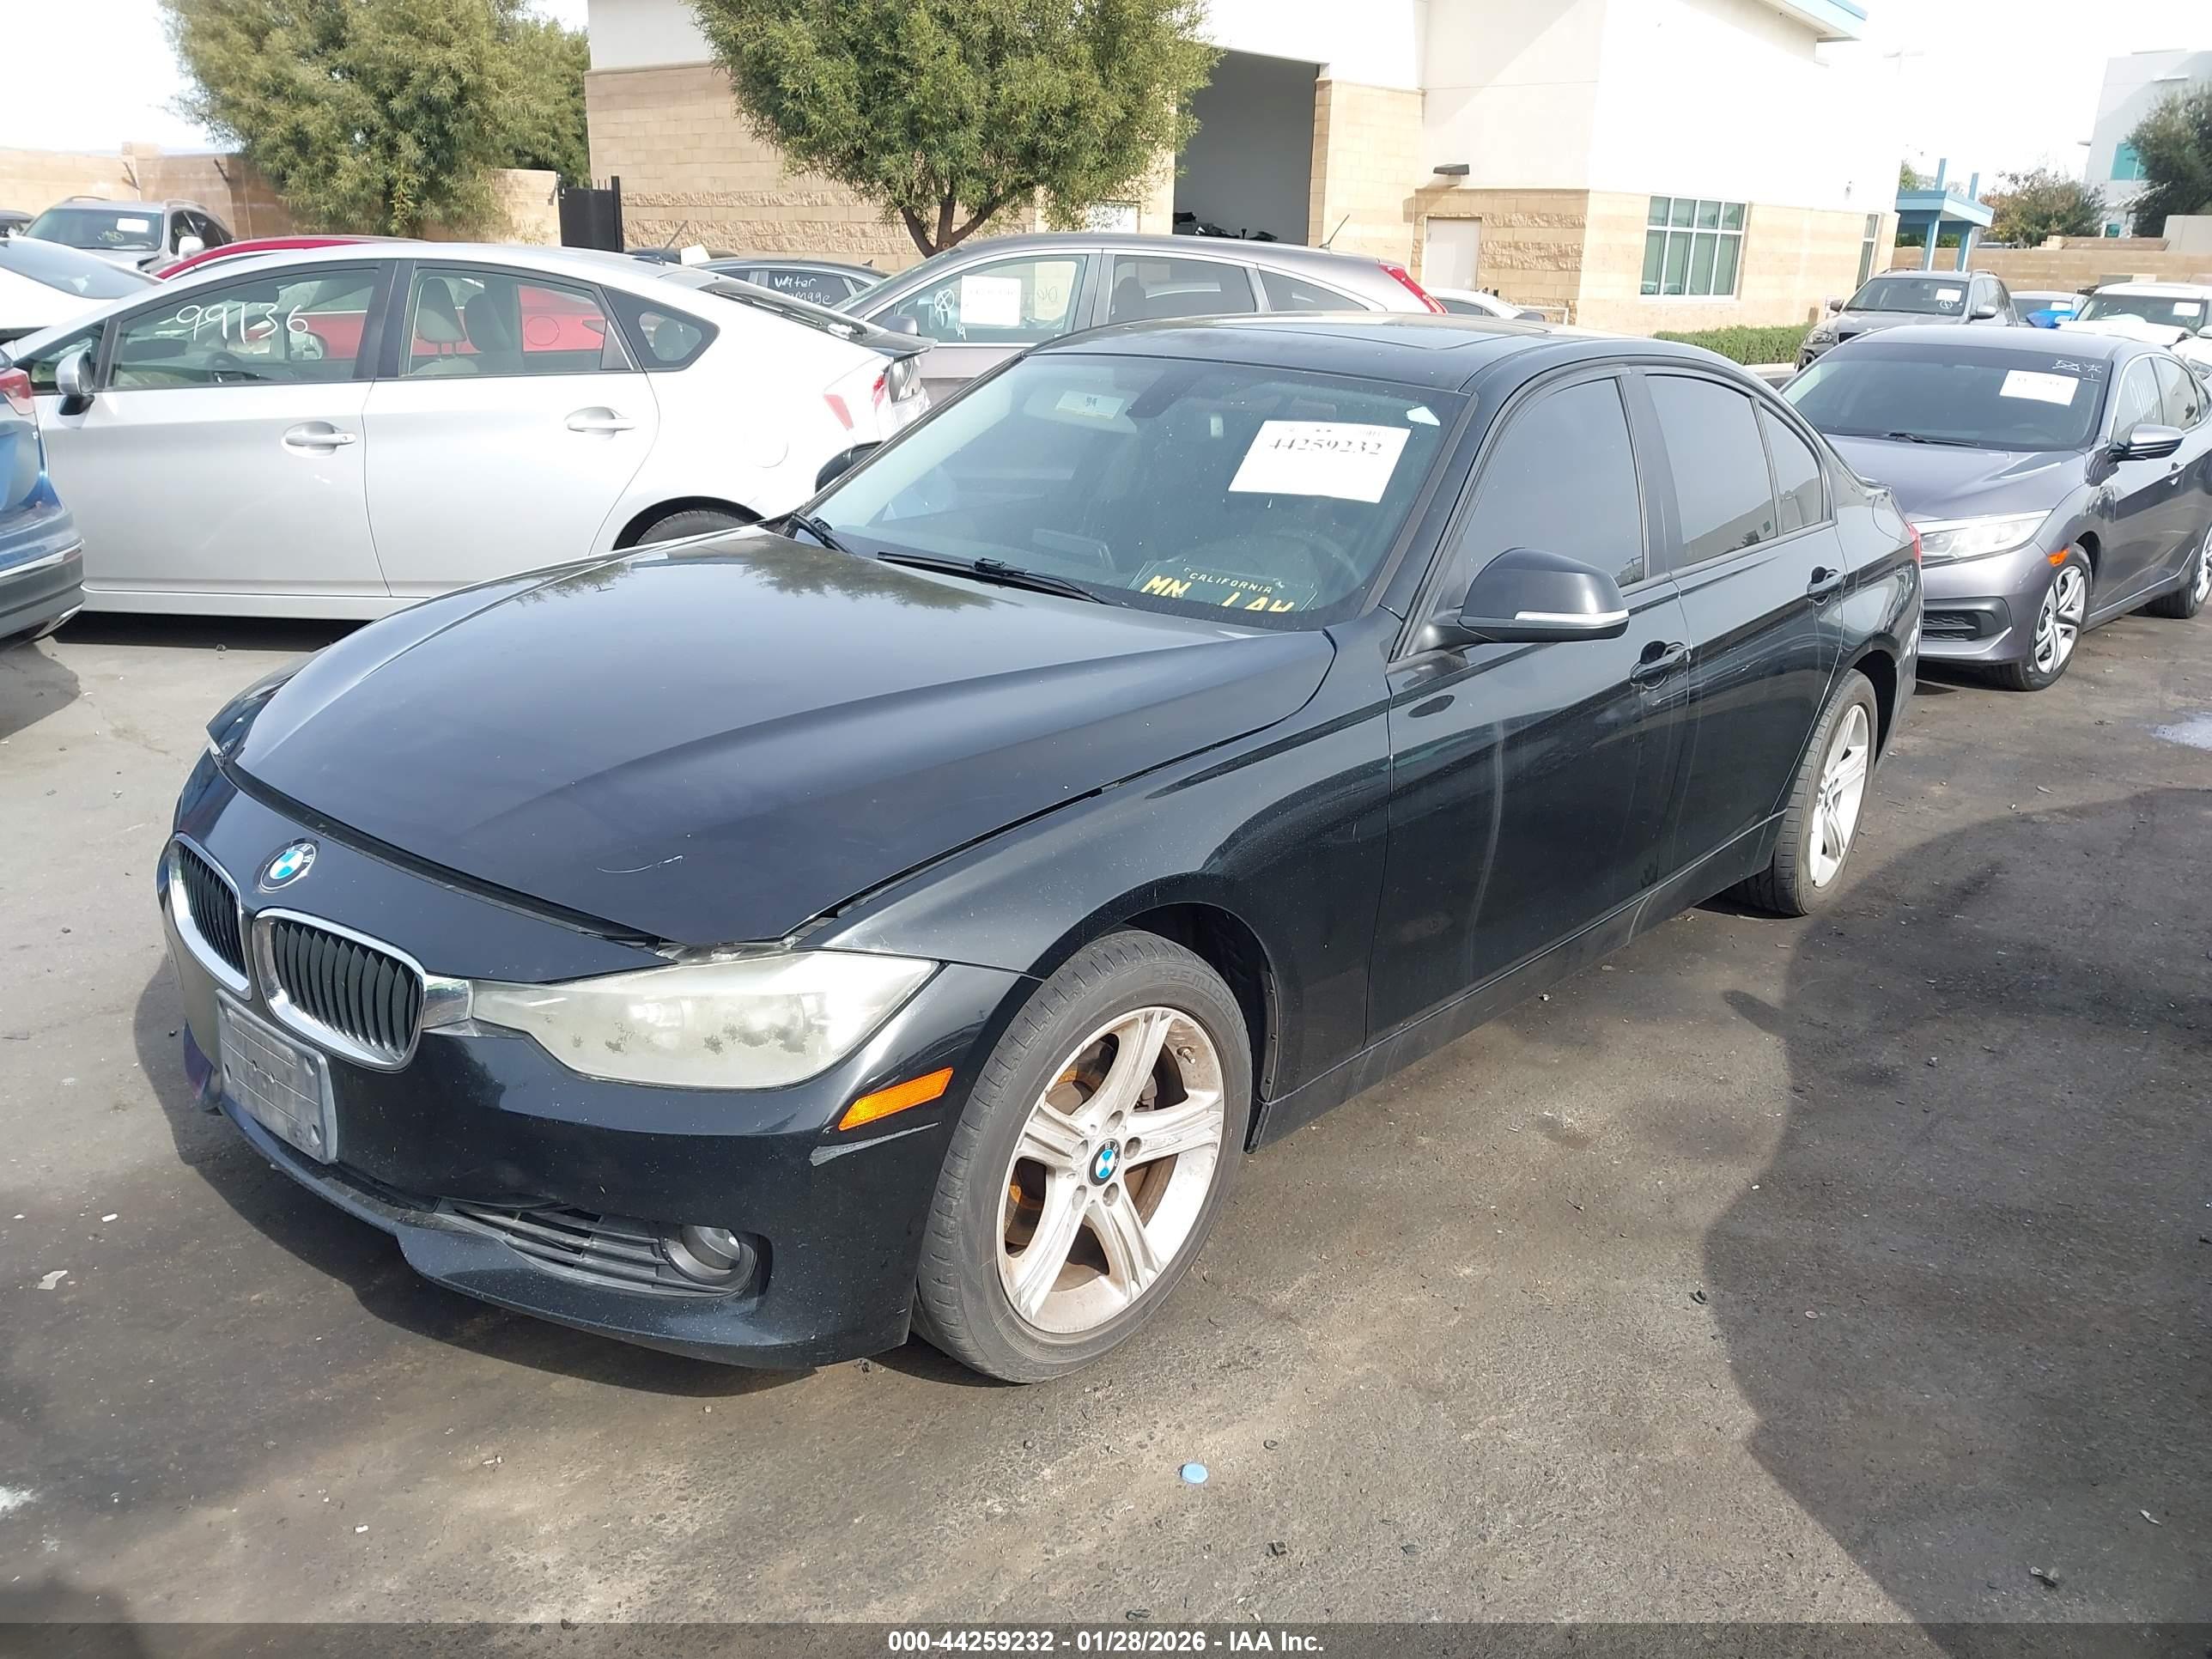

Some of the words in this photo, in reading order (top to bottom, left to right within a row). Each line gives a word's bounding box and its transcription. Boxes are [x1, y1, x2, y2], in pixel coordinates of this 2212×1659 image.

[787, 290, 833, 305] mage
[175, 302, 309, 344] 99136
[1268, 438, 1382, 455] 44259232
[1188, 572, 1273, 594] CALIFORNIA
